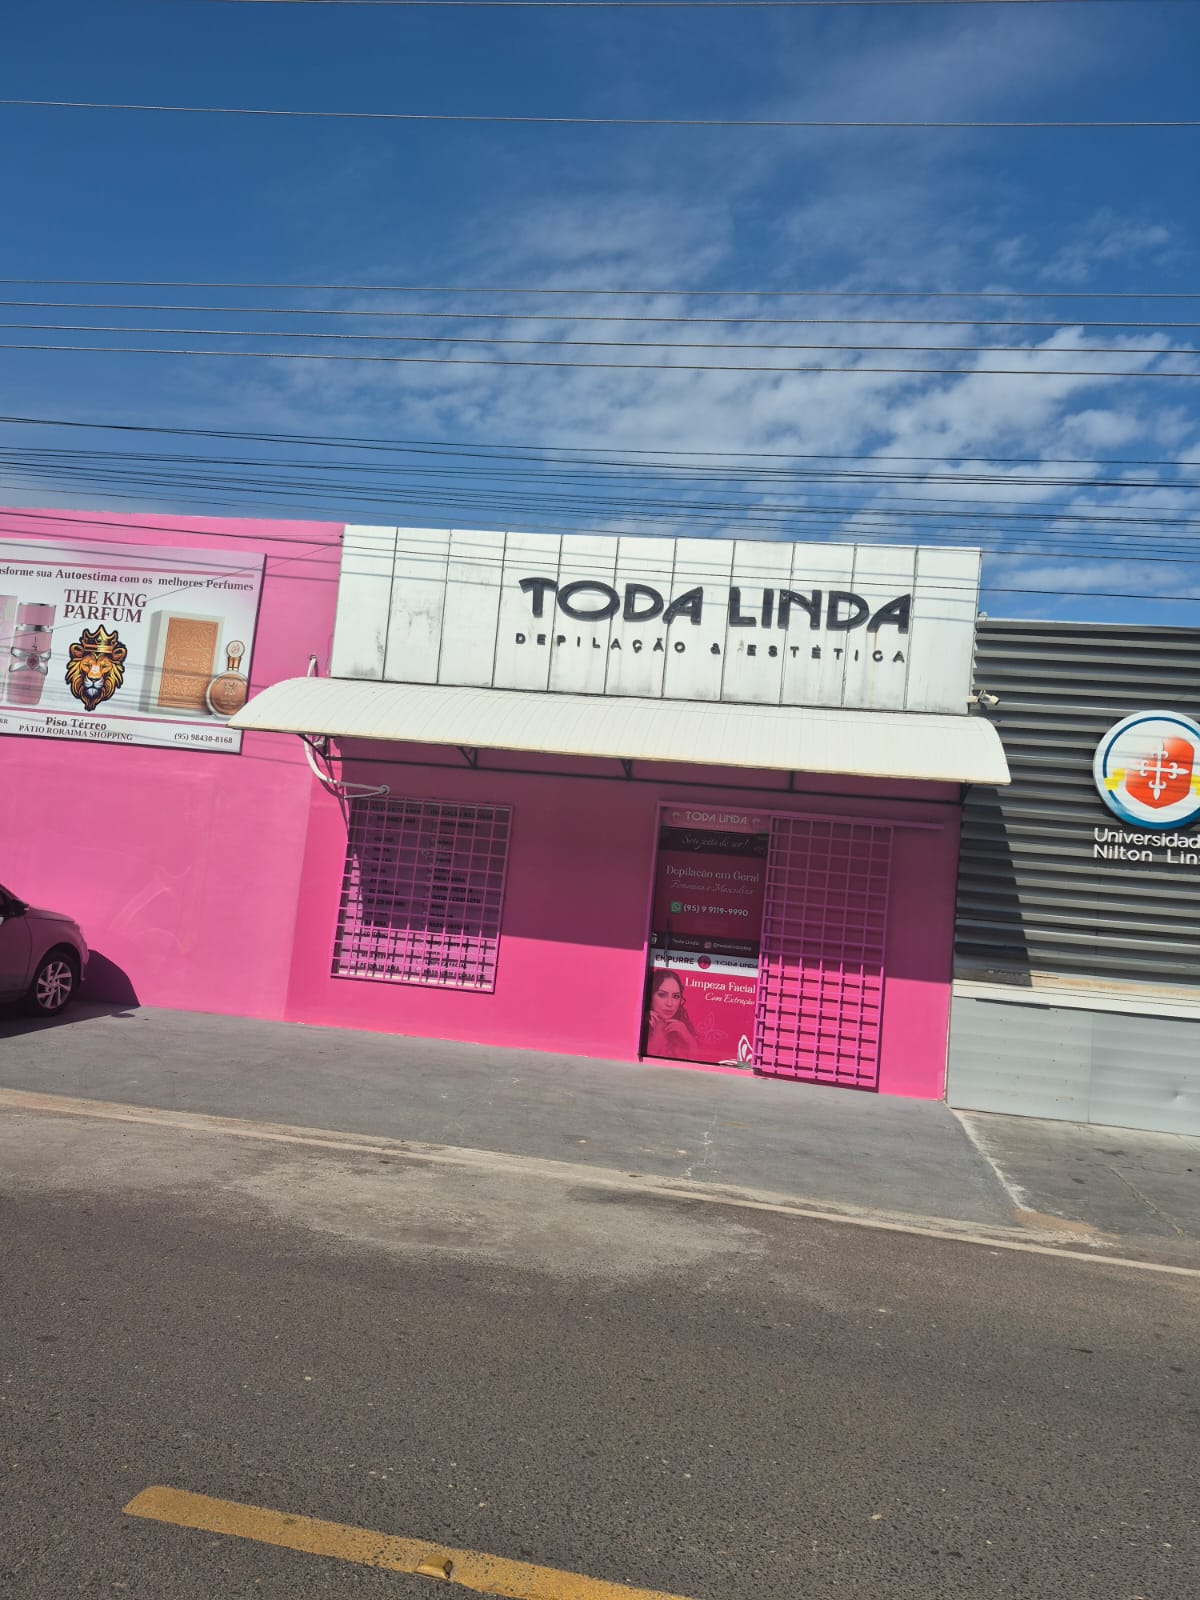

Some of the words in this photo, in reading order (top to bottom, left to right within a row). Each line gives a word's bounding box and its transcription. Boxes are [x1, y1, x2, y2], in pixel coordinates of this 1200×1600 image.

[36, 570, 52, 578] sua
[55, 569, 117, 582] Autoestima
[119, 575, 140, 584] com
[142, 576, 153, 585] os
[158, 576, 203, 588] melhores
[206, 579, 254, 592] Perfumes
[64, 589, 98, 605] THE
[103, 591, 147, 607] KING
[518, 577, 704, 626] TODA
[728, 586, 911, 634] LINDA
[63, 605, 142, 623] PARFUM
[515, 633, 686, 654] DEPILAÇÃO
[710, 642, 720, 655] &
[747, 644, 905, 663] ESTÉTICA
[45, 716, 68, 728] Piso
[71, 718, 107, 730] Térreo
[19, 724, 45, 734] PÁTIO
[46, 727, 88, 738] RORAIMA
[89, 730, 133, 741] SHOPPING
[174, 732, 189, 741] (95)
[685, 811, 715, 822] TODA
[719, 813, 747, 825] LINDA
[1093, 844, 1153, 862] Nilton
[1167, 849, 1200, 865] Lin
[715, 871, 731, 880] em
[733, 870, 760, 883] Geral
[683, 903, 700, 913] (95)
[701, 904, 707, 913] 9
[685, 977, 726, 991] Limpeza
[728, 982, 756, 994] Facial
